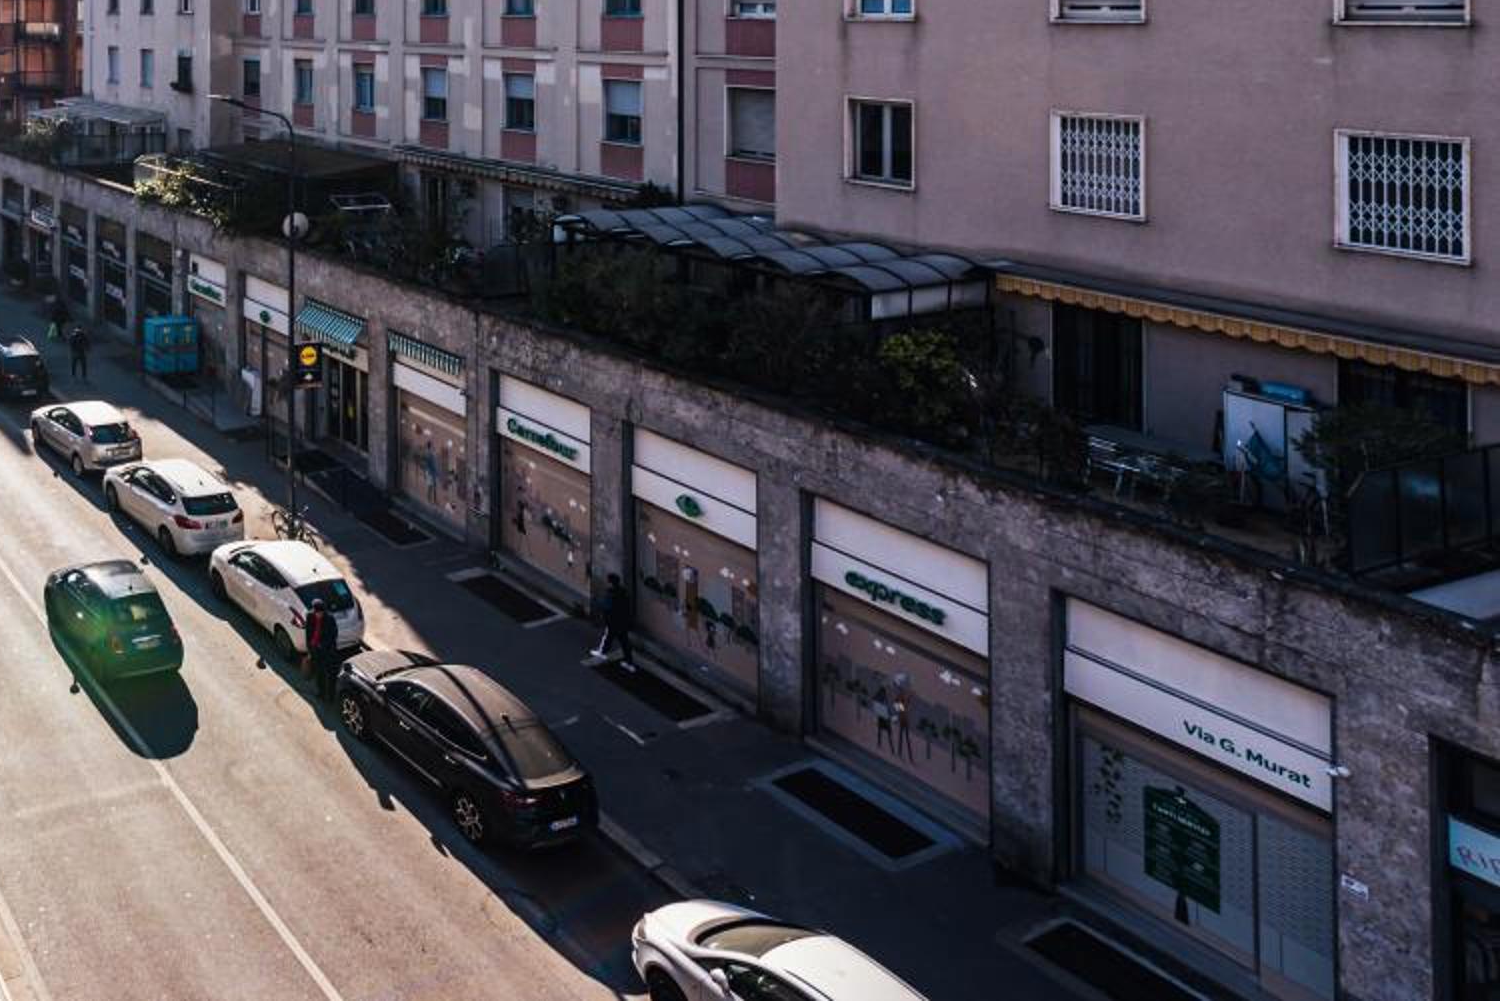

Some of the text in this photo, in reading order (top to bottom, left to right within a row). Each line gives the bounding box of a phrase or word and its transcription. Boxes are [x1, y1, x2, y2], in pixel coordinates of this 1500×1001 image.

[845, 571, 947, 626] express
[1183, 719, 1312, 788] Via G. Murat
